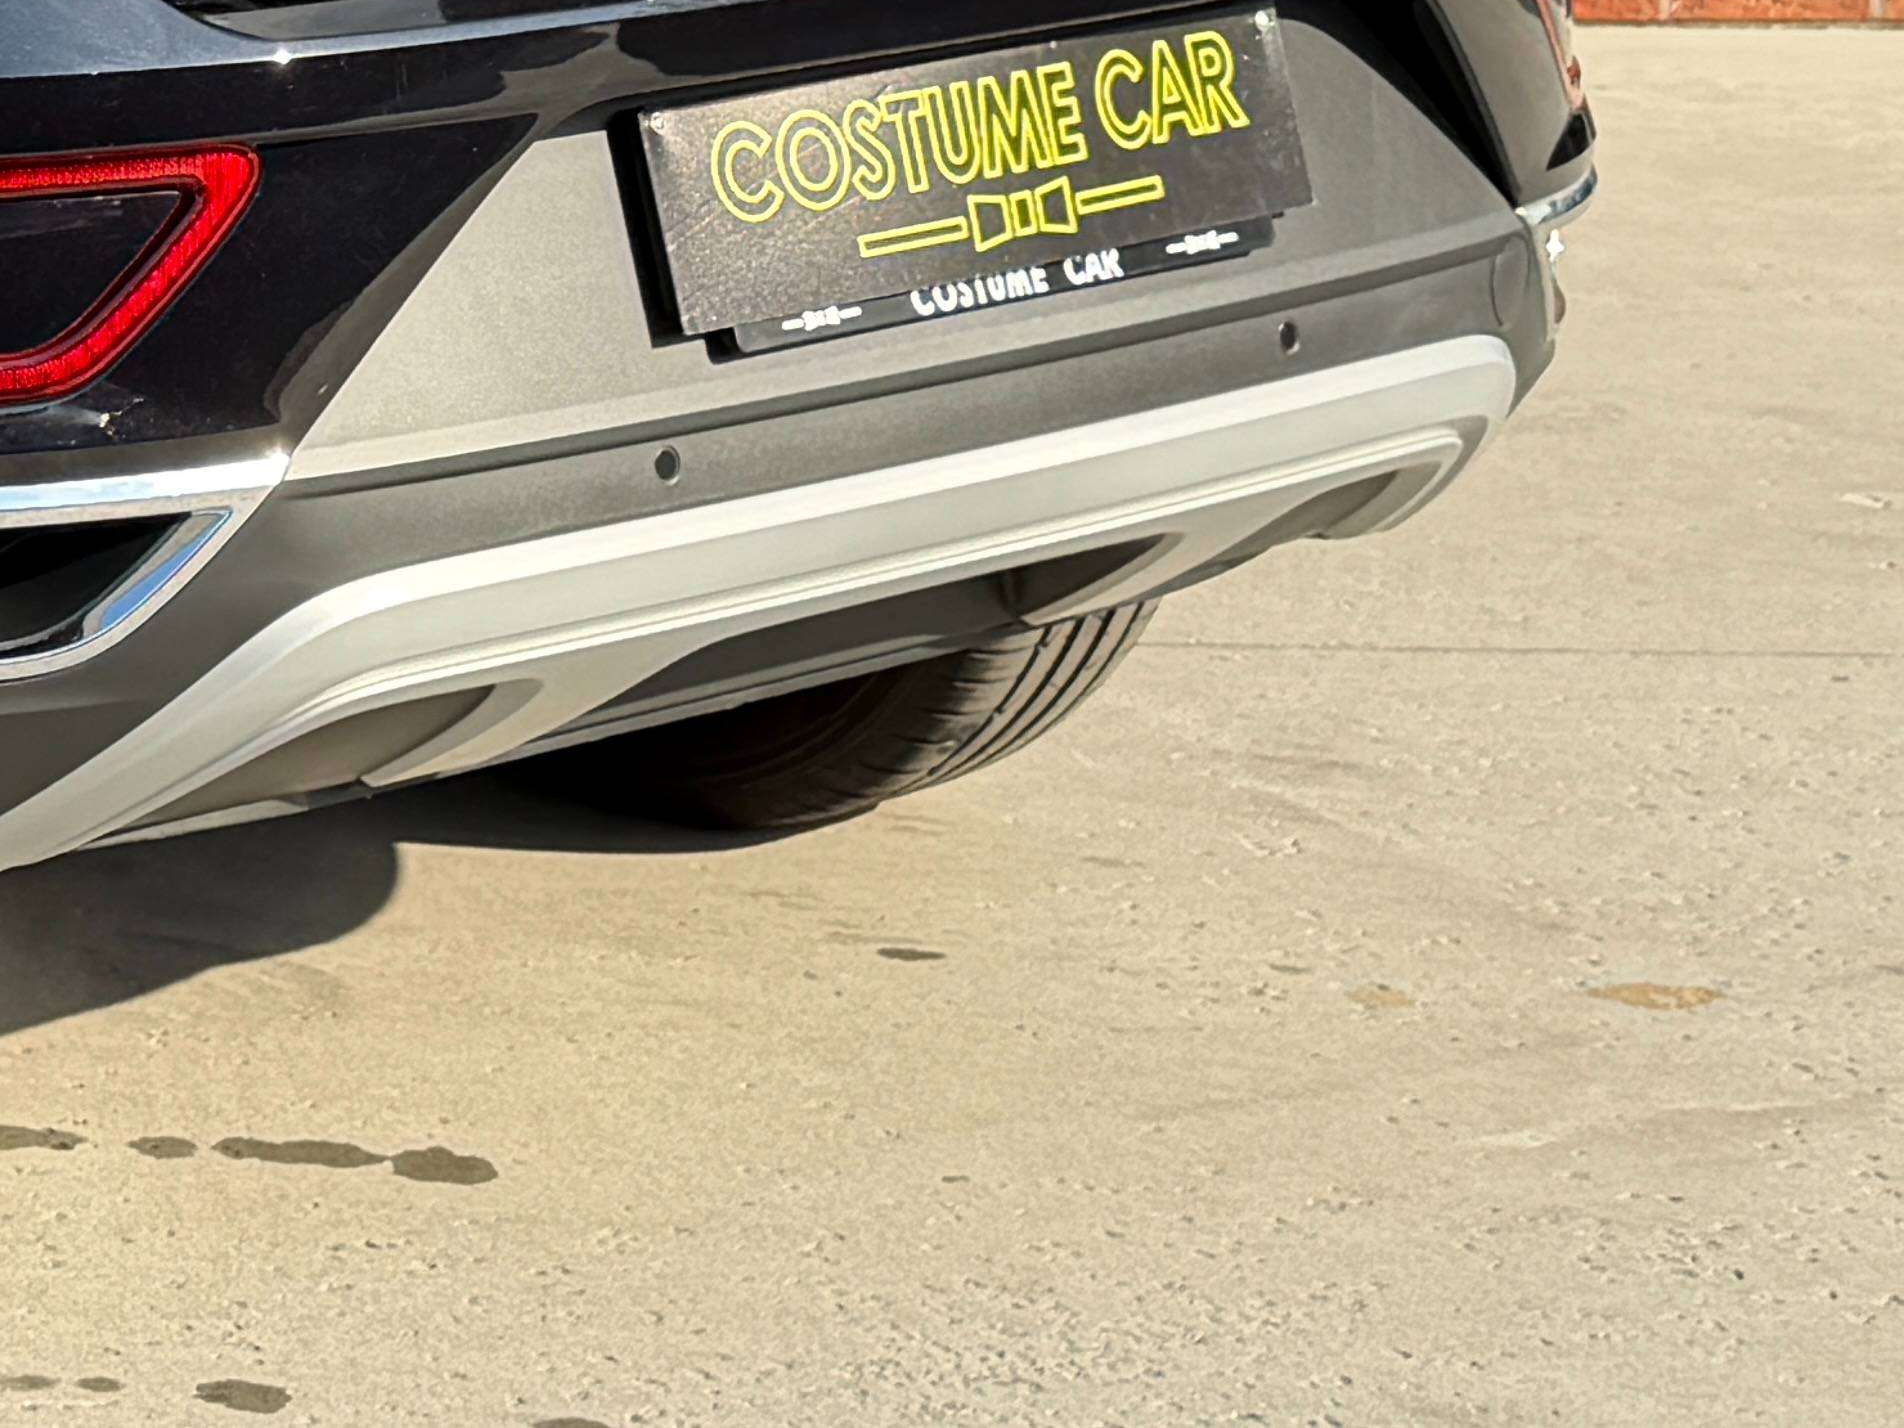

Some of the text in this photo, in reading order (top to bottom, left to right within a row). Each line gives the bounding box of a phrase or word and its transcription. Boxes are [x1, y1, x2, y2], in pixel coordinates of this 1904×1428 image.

[711, 30, 1249, 223] COSTUME CAR
[910, 248, 1124, 316] COSTUME CAR
